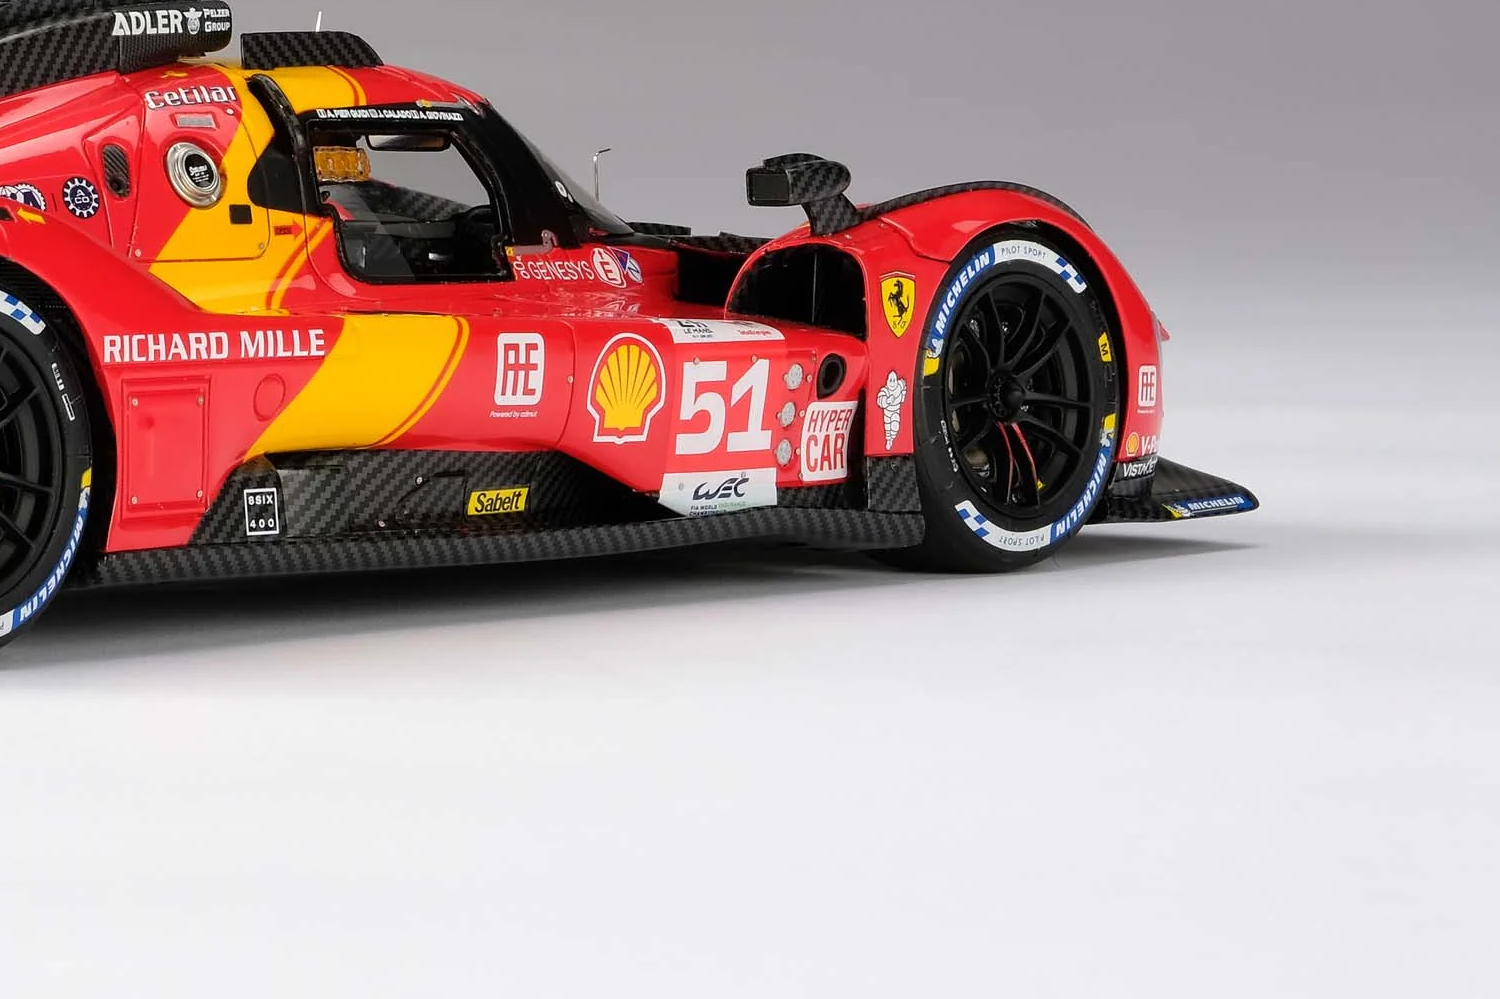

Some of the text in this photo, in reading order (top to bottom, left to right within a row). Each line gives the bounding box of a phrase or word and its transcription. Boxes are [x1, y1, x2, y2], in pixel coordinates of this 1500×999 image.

[112, 9, 183, 36] ADLER
[144, 85, 238, 109] Cetilar
[1001, 245, 1021, 256] PILOT
[528, 261, 595, 280] GENESYS
[935, 251, 990, 336] MICHELIN
[103, 328, 325, 363] RICHARD MILLE
[675, 358, 773, 456] 51
[807, 408, 853, 434] HYPER
[805, 432, 845, 473] CAR
[248, 494, 273, 506] 8SIX
[474, 490, 523, 513] Sabelt
[1056, 452, 1107, 538] MICHELIN
[1187, 496, 1245, 511] MICHELIN
[20, 515, 84, 622] MICHELIN
